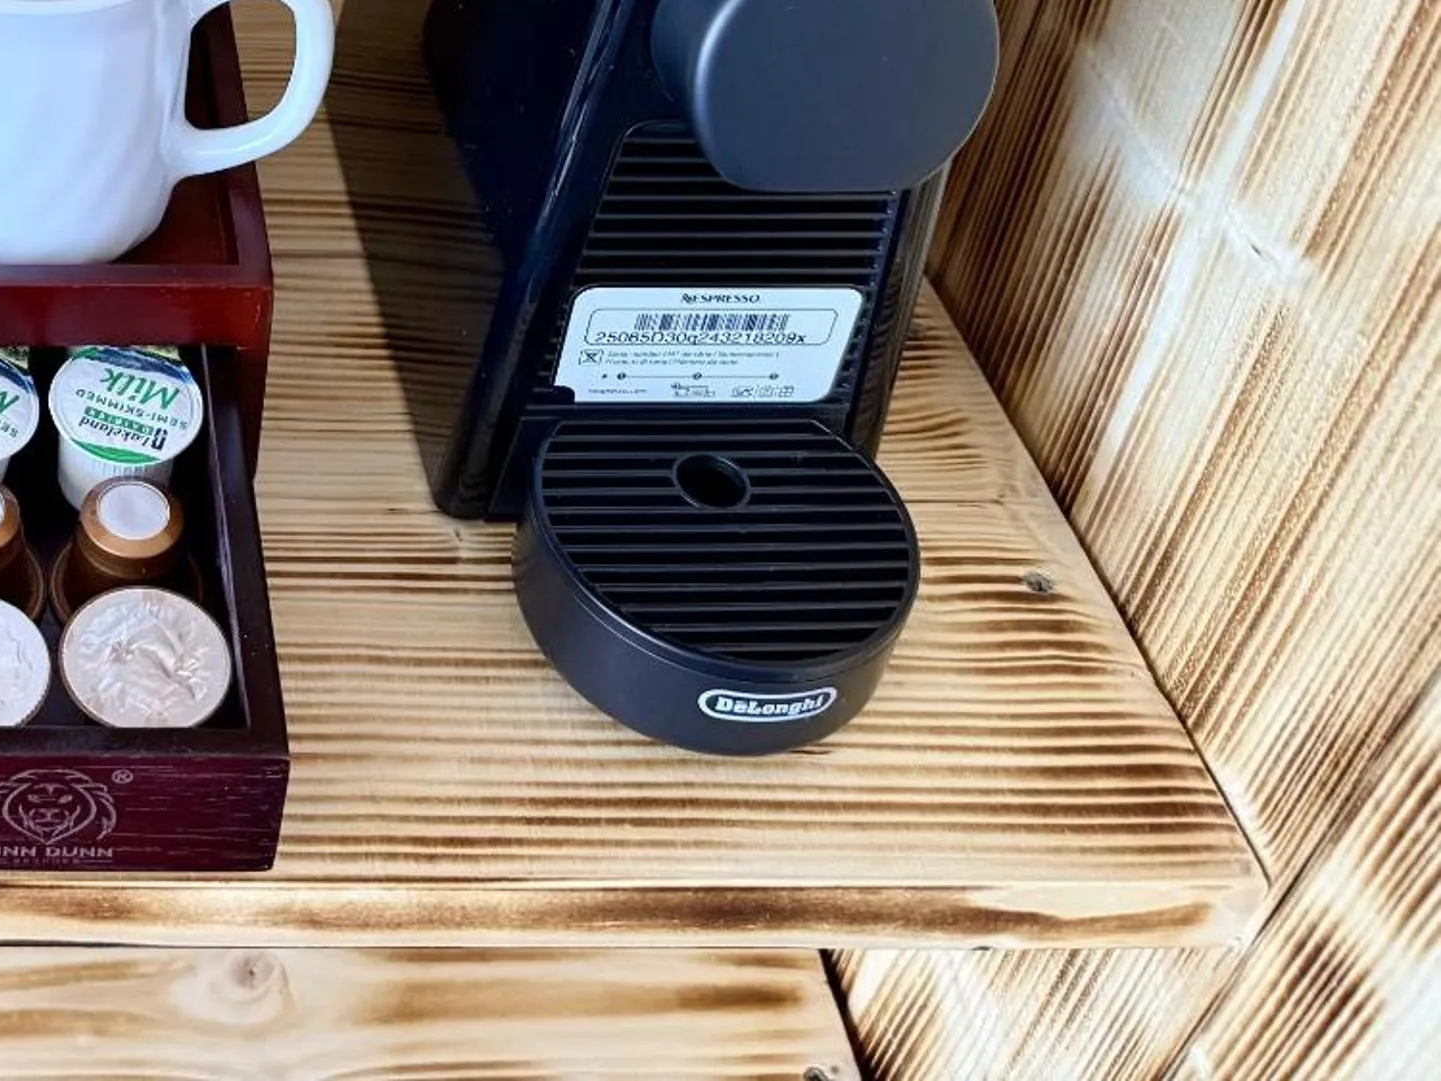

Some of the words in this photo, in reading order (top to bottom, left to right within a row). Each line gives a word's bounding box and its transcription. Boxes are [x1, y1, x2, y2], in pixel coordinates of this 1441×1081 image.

[681, 292, 761, 305] NESPRESSO
[101, 368, 180, 409] Milk
[75, 388, 188, 430] SEMI-SKIMMED
[79, 415, 150, 446] Lakeland
[45, 845, 113, 858] DUNN
